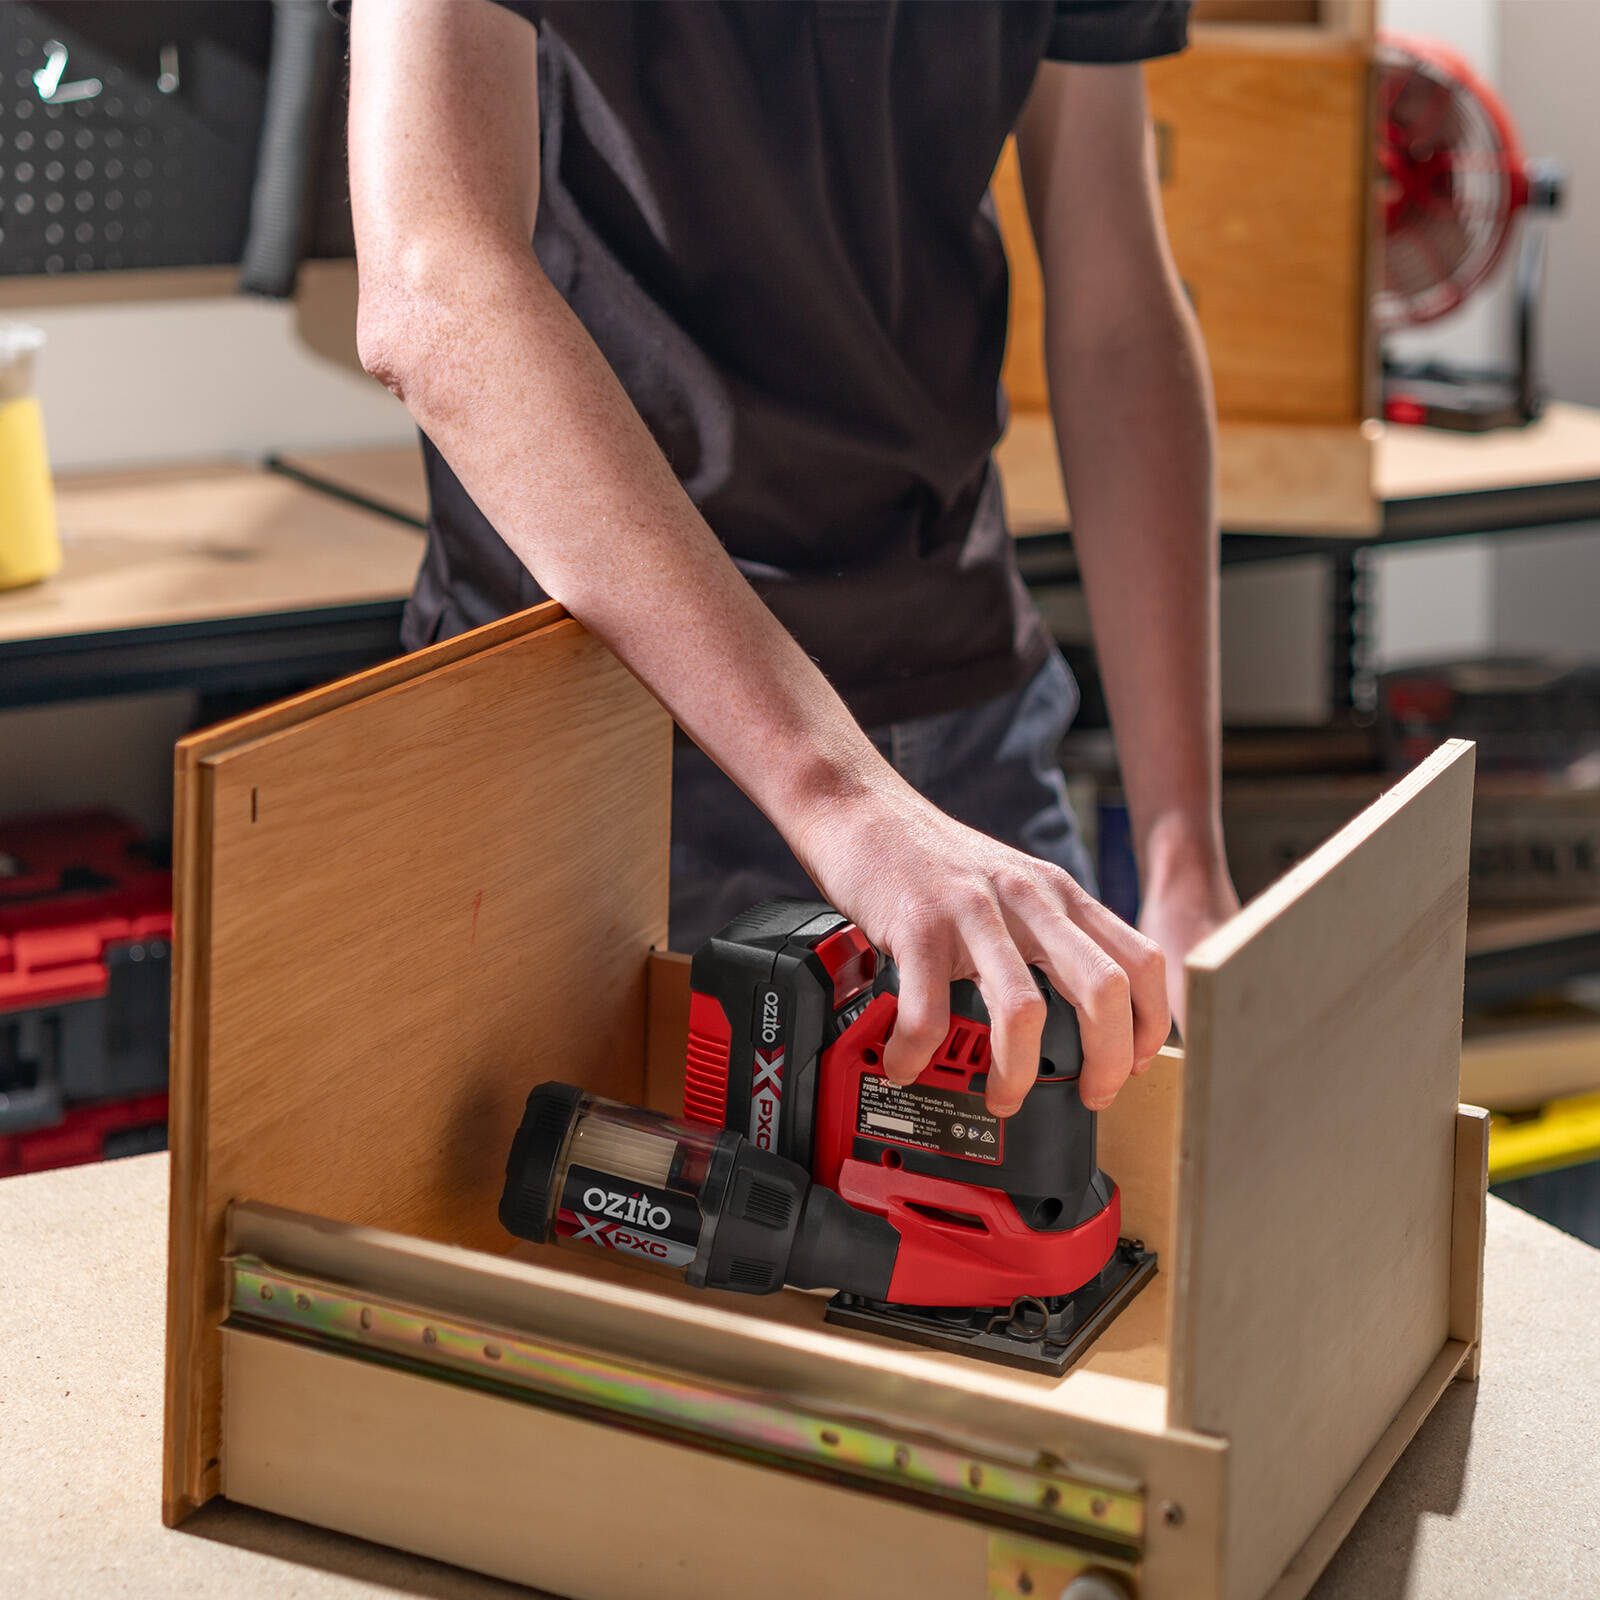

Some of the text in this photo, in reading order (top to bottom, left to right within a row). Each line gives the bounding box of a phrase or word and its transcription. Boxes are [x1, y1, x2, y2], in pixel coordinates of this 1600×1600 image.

[762, 992, 780, 1043] ozito
[924, 1097, 942, 1105] Sander
[756, 1099, 773, 1150] PXC
[583, 1187, 671, 1230] ozito
[615, 1231, 668, 1258] PXC
